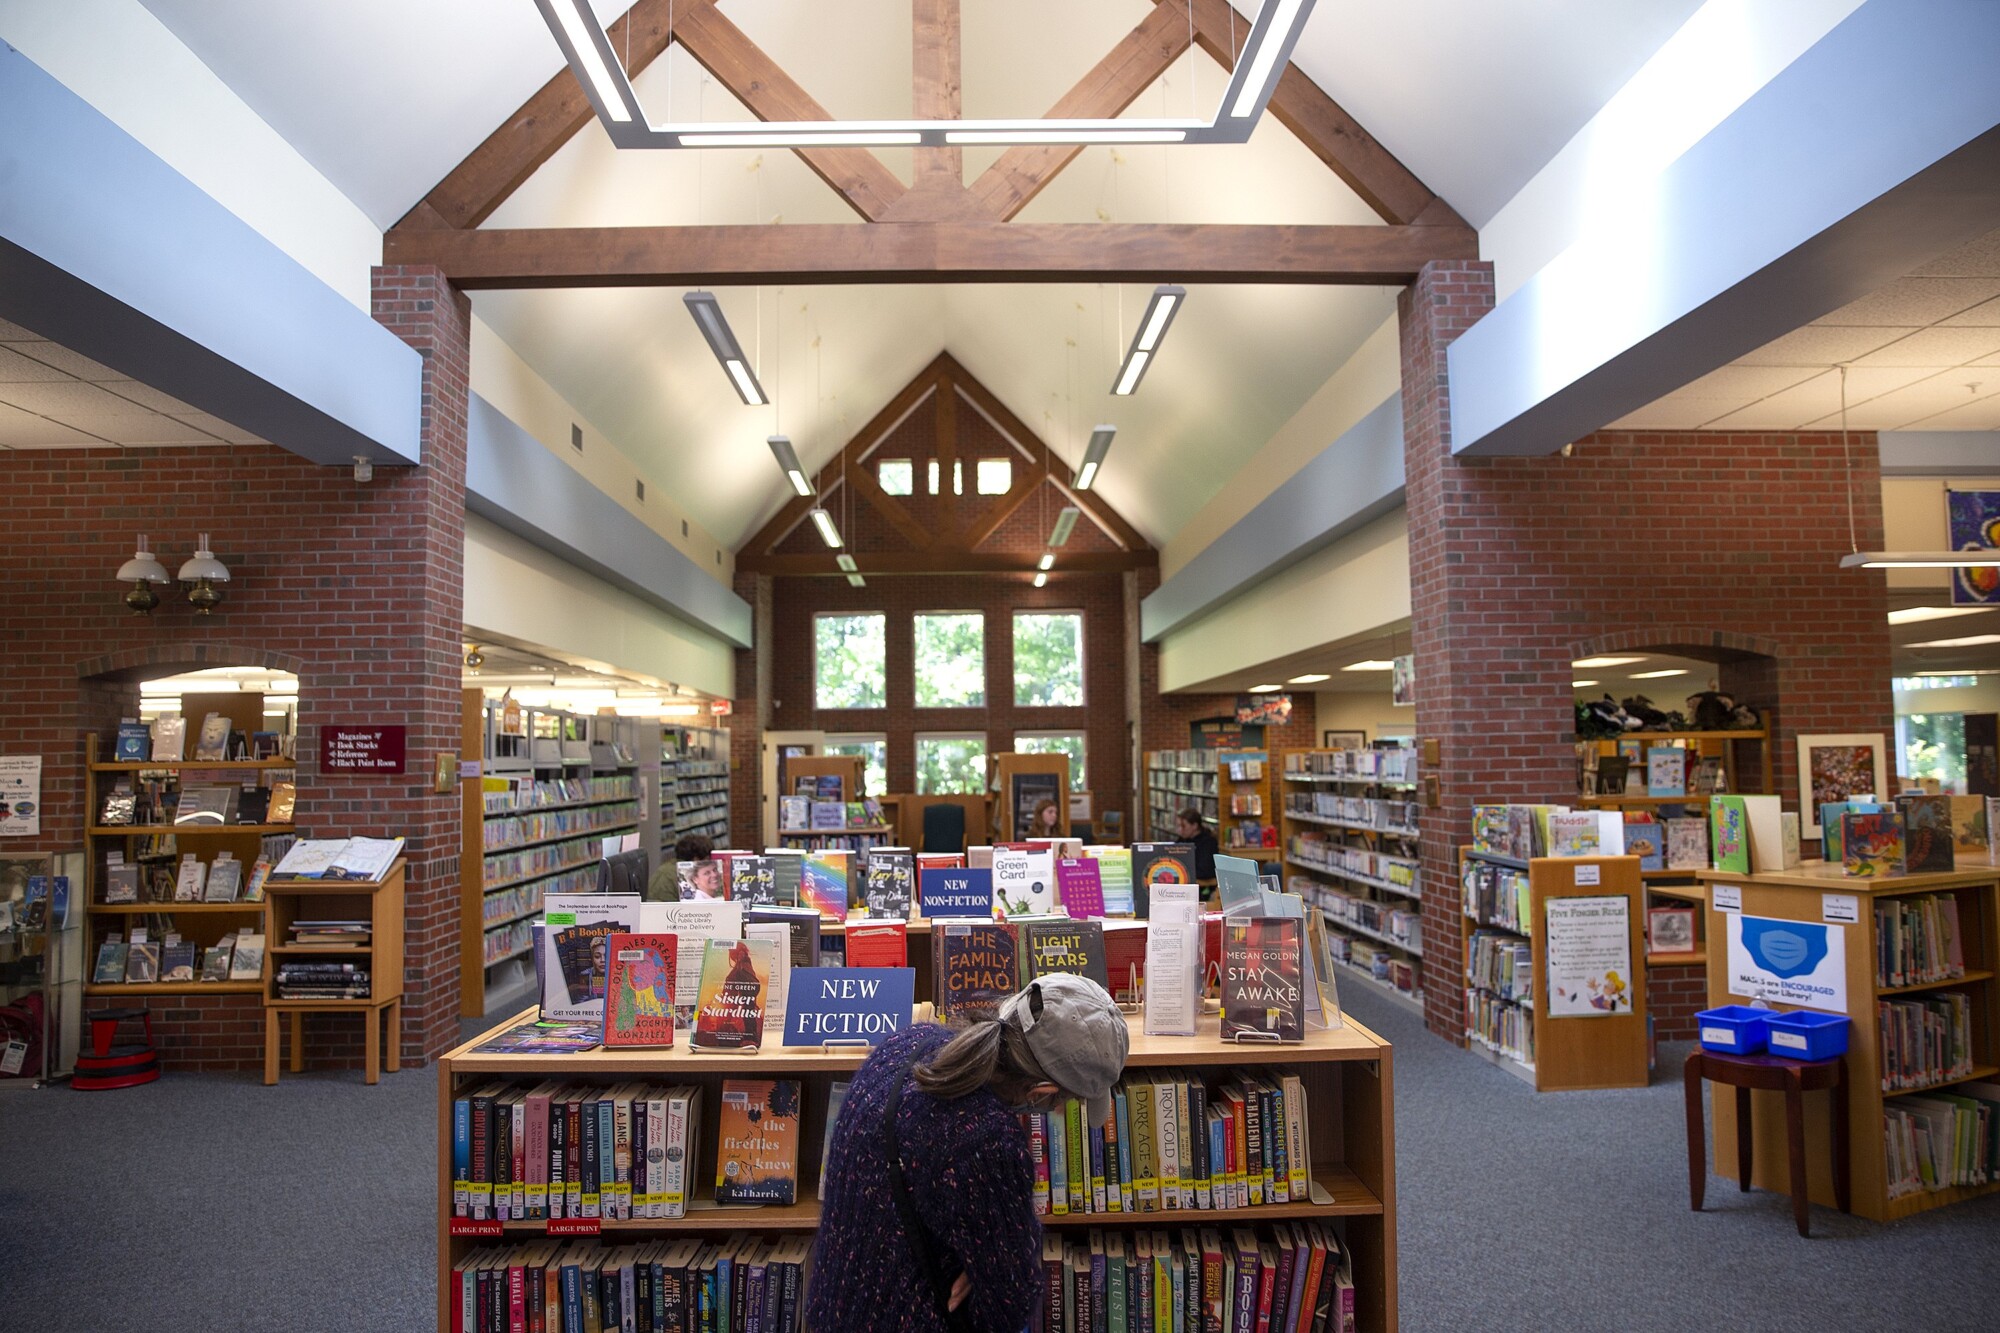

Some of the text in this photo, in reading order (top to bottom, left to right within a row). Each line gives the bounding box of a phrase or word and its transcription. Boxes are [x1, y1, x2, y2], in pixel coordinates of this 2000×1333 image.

[337, 732, 372, 741] Magazines
[337, 741, 378, 749] Book Stacks
[337, 750, 368, 758] Reference
[337, 759, 396, 768] Black Point Room
[1855, 816, 1882, 837] ART
[1869, 830, 1898, 853] DOG
[996, 861, 1028, 870] Green
[1000, 871, 1026, 880] Card
[944, 880, 968, 890] NEW
[924, 896, 988, 906] NON-FICTION
[1570, 908, 1600, 918] FINGER
[963, 932, 996, 950] THE
[1034, 936, 1080, 950] LIGHT
[950, 952, 1010, 970] FAMILY
[1034, 953, 1088, 966] YEARS
[1227, 952, 1298, 960] MEGAN GOLDIN
[948, 971, 1010, 990] CHAO
[1228, 967, 1267, 982] STAY
[820, 980, 881, 998] NEW
[1236, 987, 1297, 1002] AWAKE
[1740, 975, 1766, 986] MASS
[1780, 981, 1835, 996] ENCOURAGED
[714, 992, 756, 1004] Sister
[1782, 988, 1812, 1002] Library!
[702, 1006, 762, 1018] Stardust
[797, 1013, 899, 1033] FICTION
[617, 1030, 666, 1038] GONZALEZ
[731, 1102, 765, 1112] what
[474, 1111, 486, 1138] DAVID
[764, 1120, 786, 1132] the
[1134, 1091, 1150, 1160] DARK AGE
[1160, 1088, 1175, 1158] IRON GOLD
[1247, 1091, 1260, 1154] THE HACIENDA
[1275, 1096, 1285, 1150] COUNTERFEIT
[616, 1106, 628, 1182] J.A. JANCE NOTHING
[724, 1138, 780, 1150] fireflies
[1292, 1121, 1300, 1158] SWITCHBOARD
[1032, 1138, 1042, 1163] ANNA
[553, 1150, 562, 1170] POINT
[754, 1158, 792, 1170] knew
[732, 1189, 780, 1198] kai harris
[1281, 1255, 1290, 1274] LIKE
[1093, 1262, 1102, 1292] LINDSEY
[1189, 1256, 1198, 1316] JANET EVANOVICH
[1306, 1256, 1322, 1312] Yoga Pant Nation
[512, 1270, 521, 1304] WAHALA
[664, 1274, 672, 1307] ROLLINS
[1112, 1266, 1122, 1324] TRUST
[1052, 1280, 1060, 1320] BLADED
[1276, 1285, 1286, 1314] SISTER
